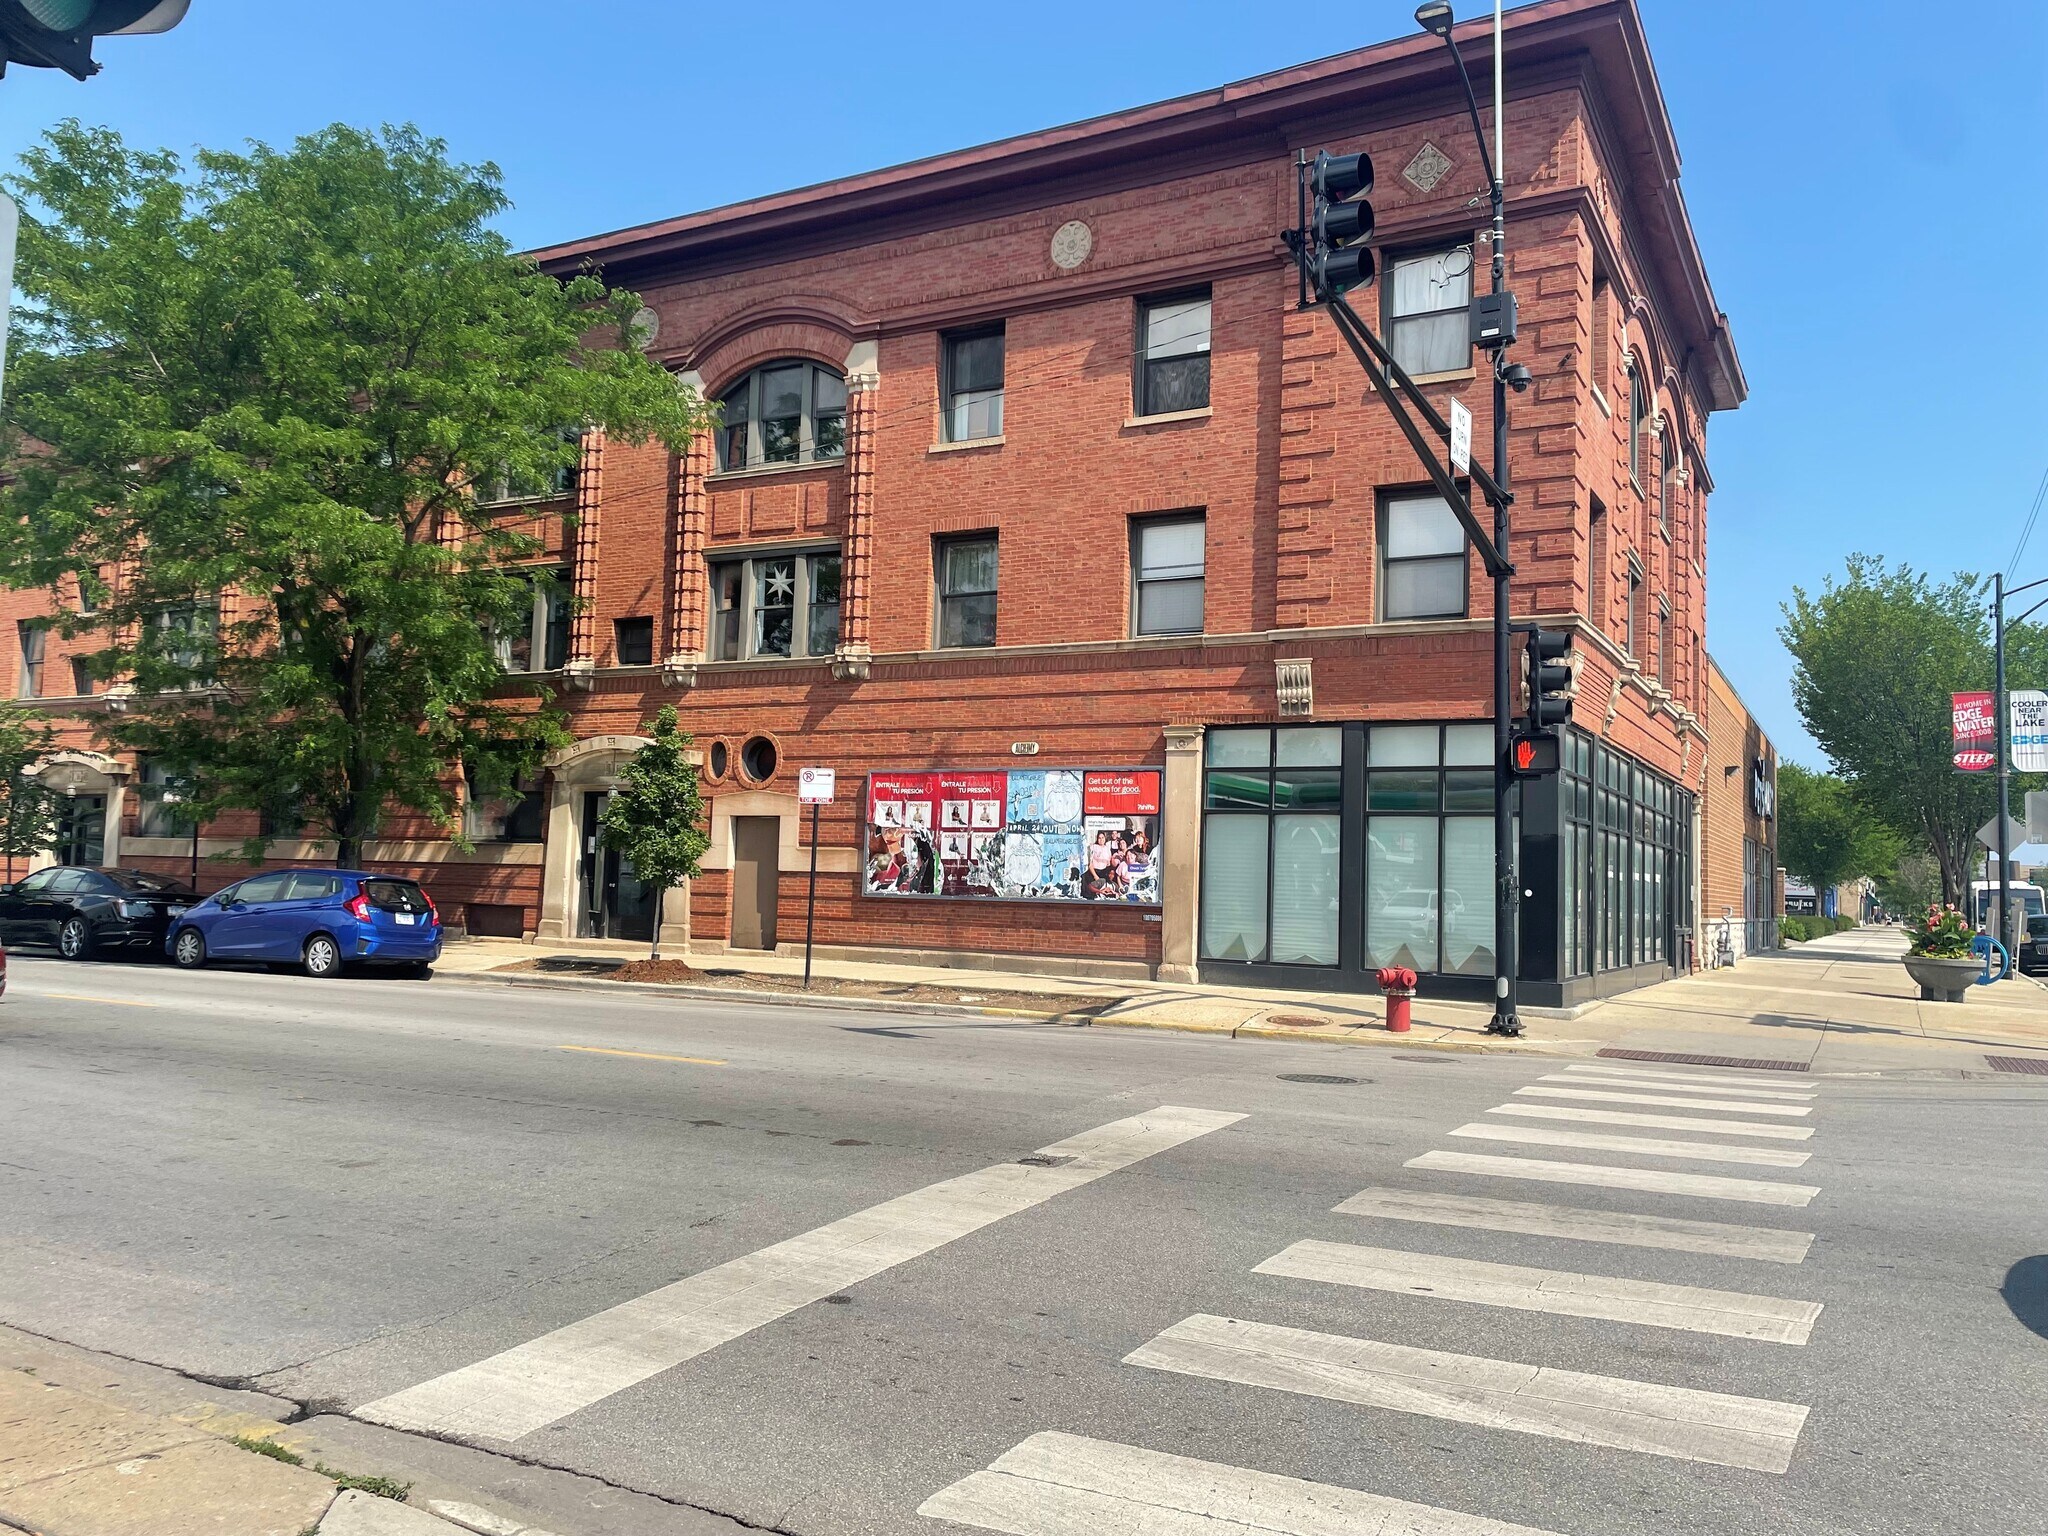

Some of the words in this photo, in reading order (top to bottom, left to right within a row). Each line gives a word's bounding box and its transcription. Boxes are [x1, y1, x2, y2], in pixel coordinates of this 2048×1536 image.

[1963, 700, 1983, 708] HOME
[2011, 700, 2048, 708] COOLER
[1953, 707, 1983, 723] EDGE
[1955, 716, 1994, 732] WATER
[2015, 719, 2045, 727] LAKE
[1955, 731, 1974, 740] SINCE
[1953, 753, 1994, 764] STEEP
[1088, 777, 1100, 785] Get
[1113, 777, 1121, 785] of
[1122, 777, 1134, 785] the
[1121, 786, 1141, 794] good.
[1044, 825, 1058, 833] OUT
